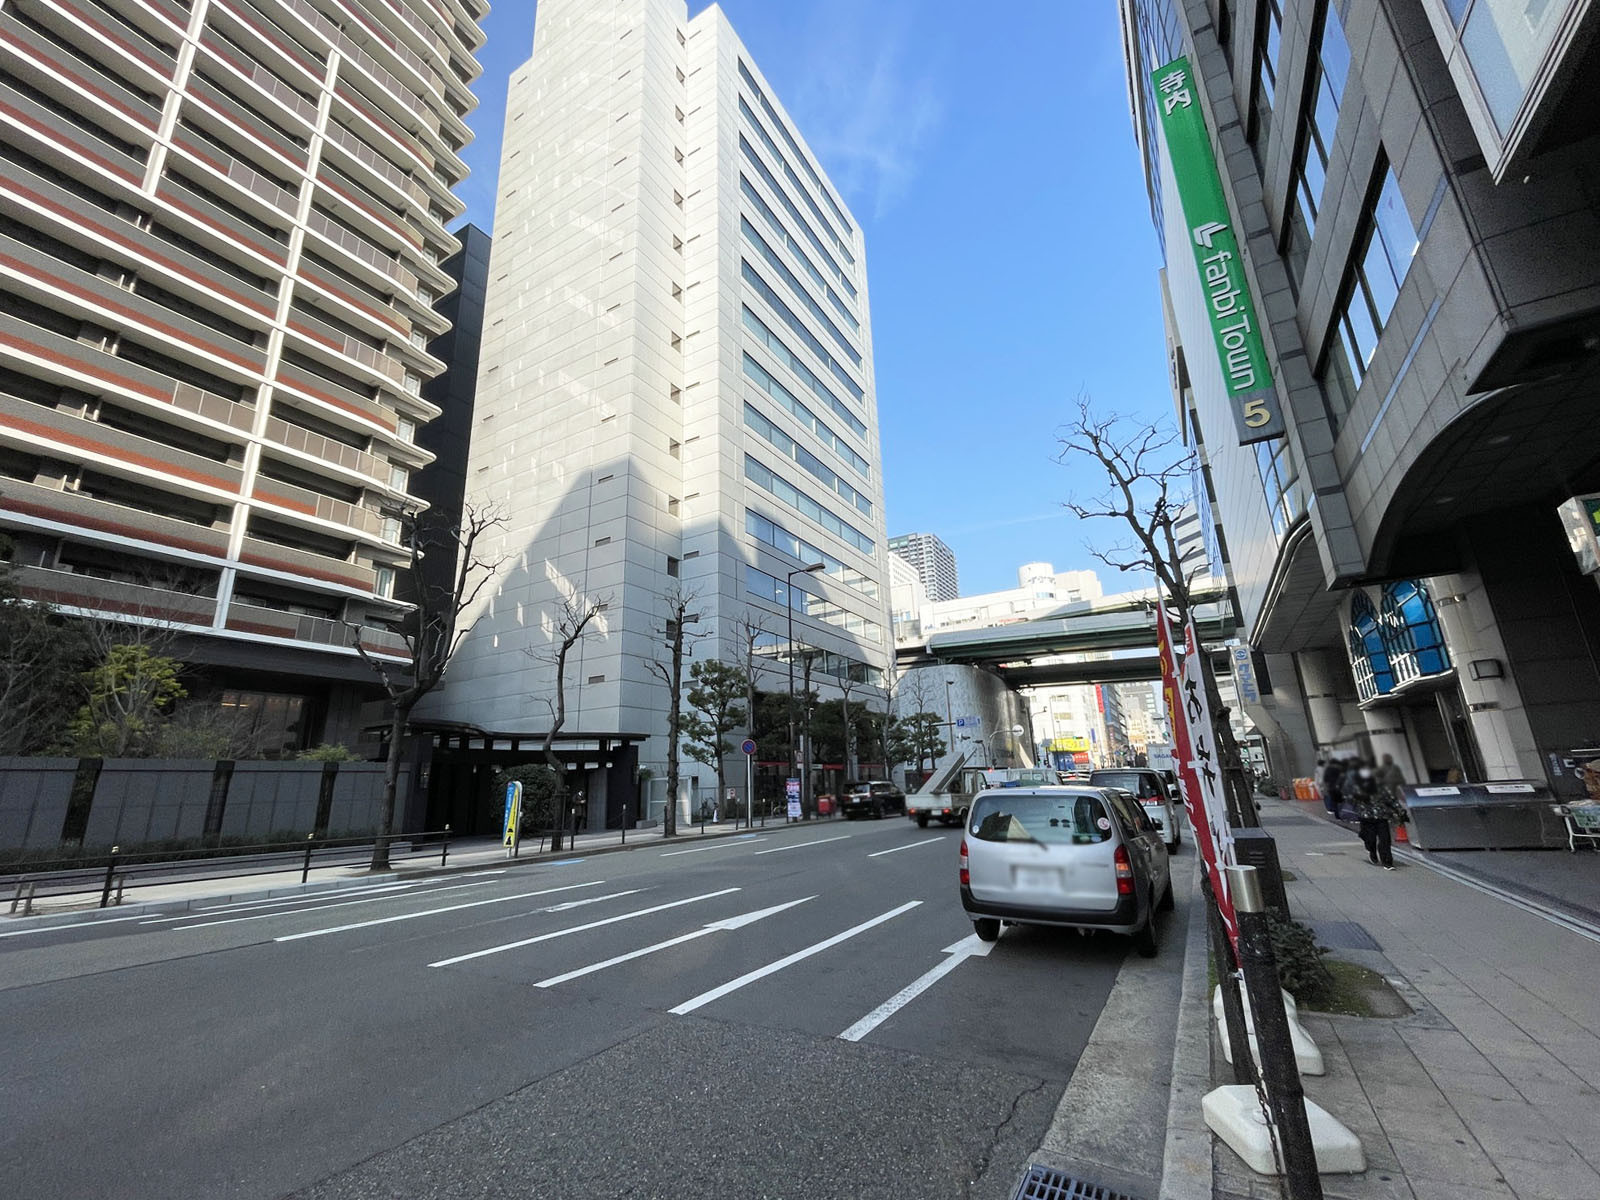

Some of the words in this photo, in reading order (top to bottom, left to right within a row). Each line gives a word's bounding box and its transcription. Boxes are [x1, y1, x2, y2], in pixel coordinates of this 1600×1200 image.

[1203, 250, 1246, 319] fanbi
[1220, 314, 1257, 390] Town
[1244, 398, 1271, 428] 5
